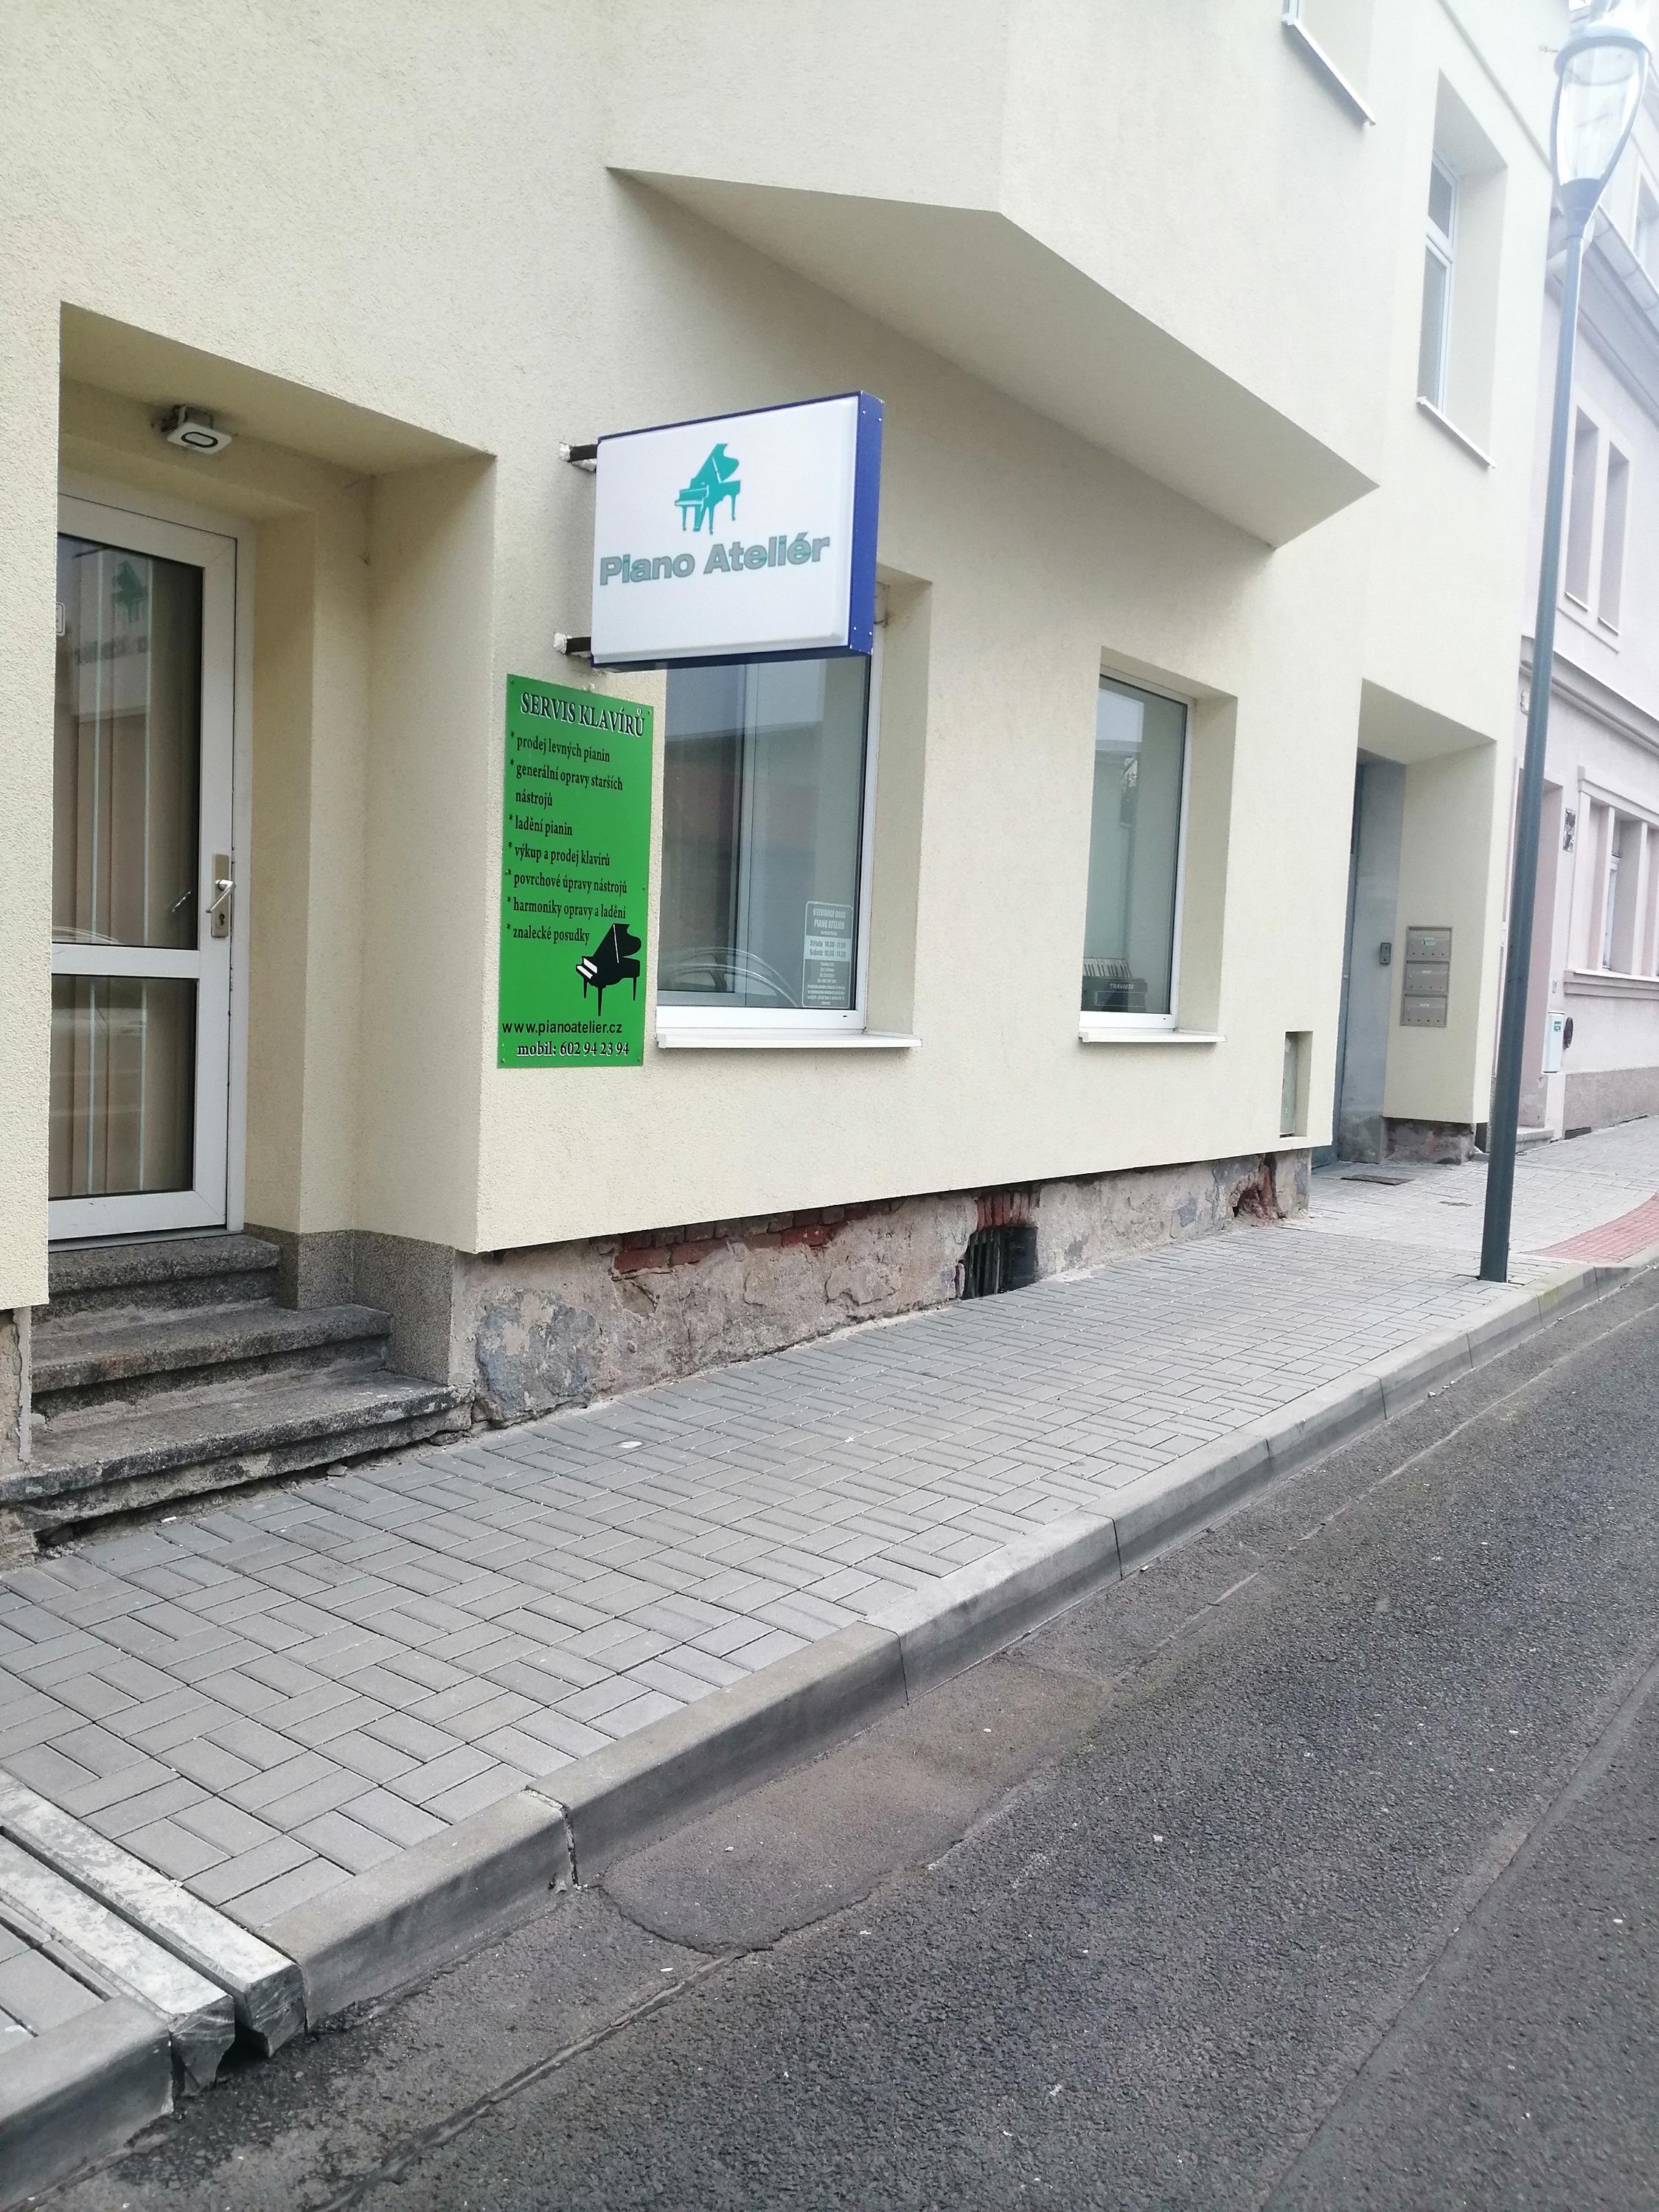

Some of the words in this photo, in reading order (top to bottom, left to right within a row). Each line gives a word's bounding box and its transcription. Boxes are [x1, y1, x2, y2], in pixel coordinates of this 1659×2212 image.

[599, 552, 695, 586] Piano
[703, 532, 830, 575] Ateliér
[521, 692, 575, 724] SERVIS
[578, 705, 644, 737] KLAVÍRŮ
[516, 736, 546, 755] prodej
[548, 740, 582, 759] levných
[583, 746, 610, 763] pianin
[516, 765, 559, 781] generální
[560, 772, 591, 788] opravy
[591, 773, 623, 790] starších
[515, 787, 552, 810] nástrojů
[515, 815, 543, 832] ladění
[545, 821, 573, 837] pianin
[514, 844, 542, 863] výkup
[543, 849, 549, 860] a
[550, 848, 579, 867] prodej
[581, 850, 610, 866] klavírů
[514, 872, 560, 888] povrchové
[563, 874, 592, 894] úpravy
[594, 874, 627, 897] nástrojů
[513, 897, 563, 917] harmoniky
[563, 905, 593, 920] opravy
[594, 907, 599, 917] a
[600, 903, 626, 919] ladění
[512, 925, 552, 940] znalecké
[553, 928, 591, 946] posudky
[501, 1020, 623, 1036] www.pianoatelier.cz
[516, 1040, 557, 1057] mobil:
[559, 1041, 581, 1057] 602
[583, 1042, 597, 1057] 94
[599, 1042, 613, 1057] 23
[615, 1042, 629, 1057] 94
